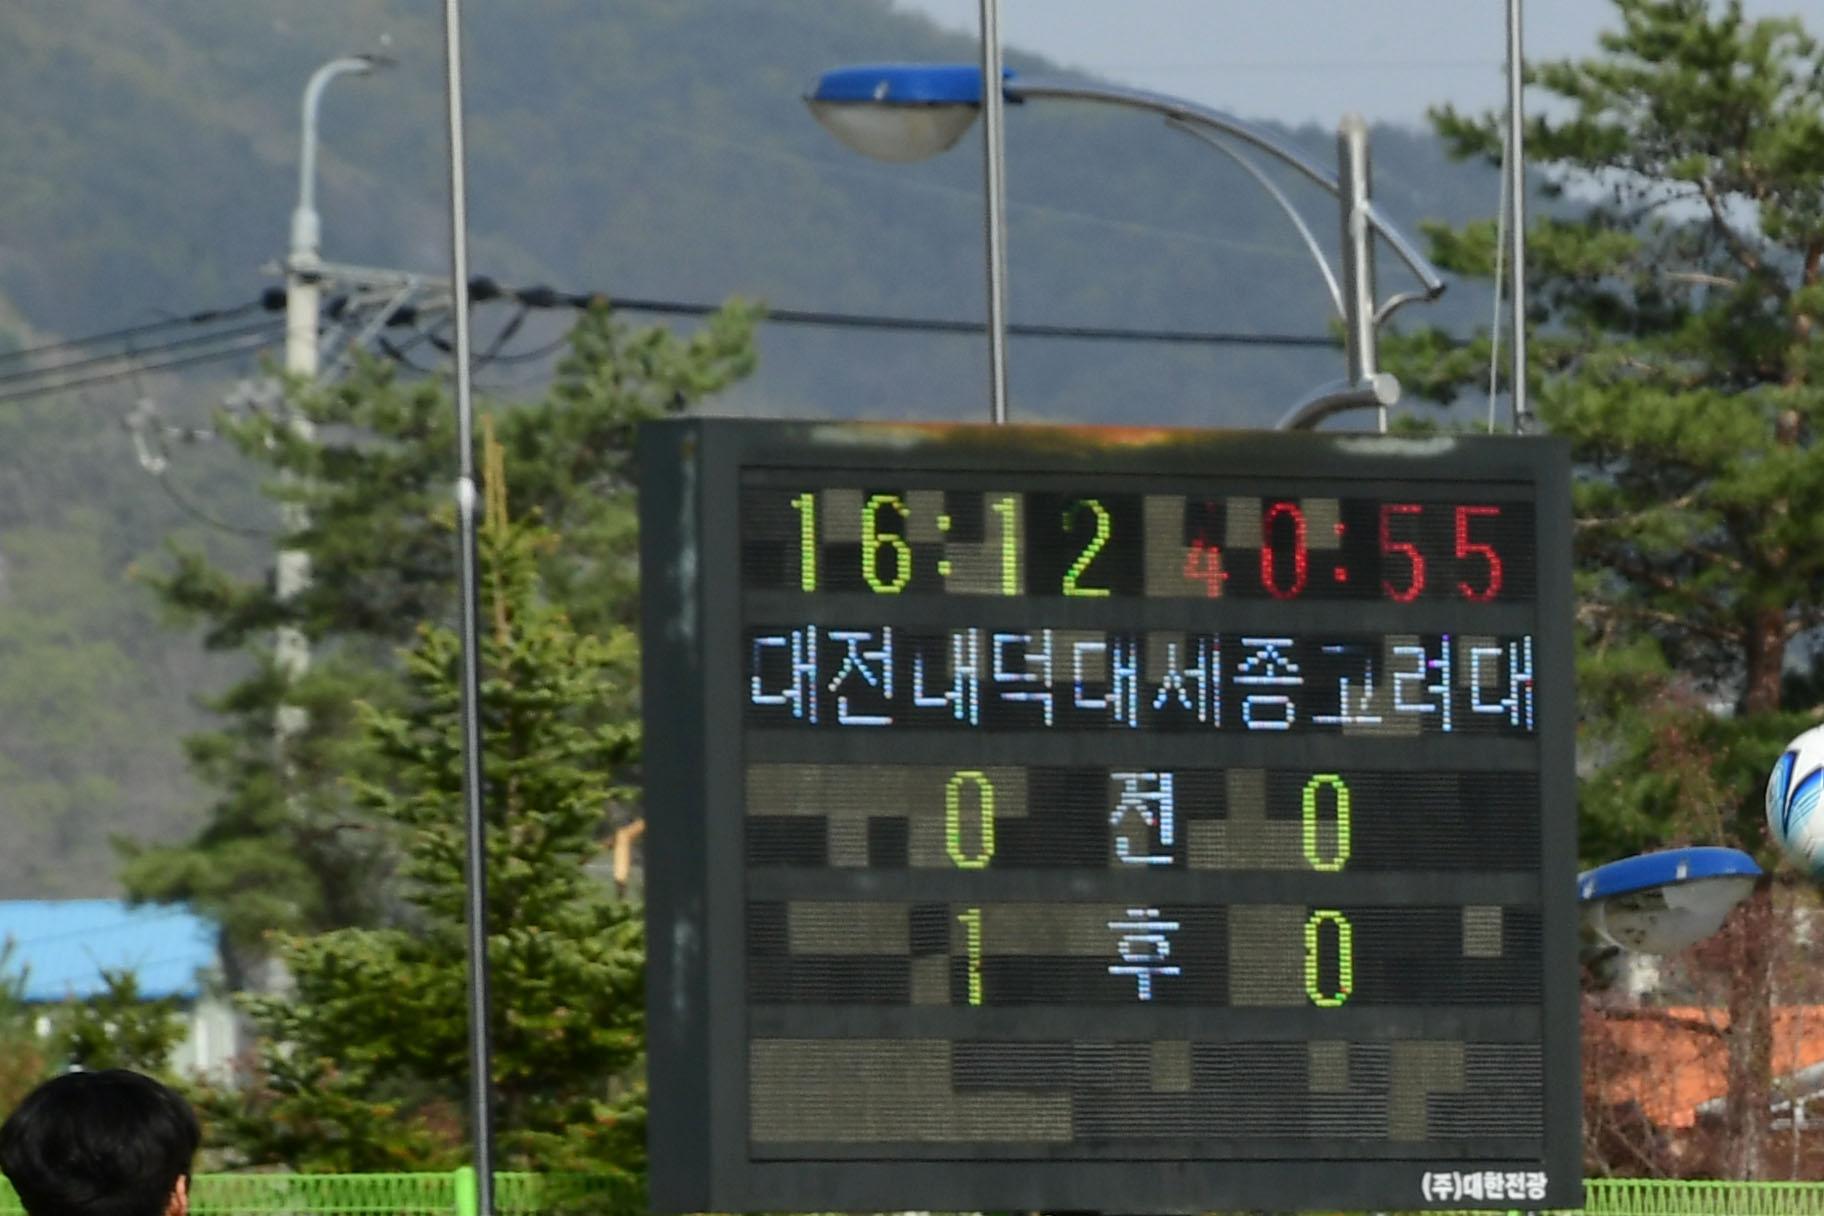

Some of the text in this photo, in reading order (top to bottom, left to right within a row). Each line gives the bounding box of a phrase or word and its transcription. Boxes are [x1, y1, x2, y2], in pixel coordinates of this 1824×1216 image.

[791, 493, 1111, 596] 16:12
[1183, 501, 1503, 602] 40:55
[945, 770, 1352, 871] 0 전 0
[957, 908, 1353, 1006] 1 후 0
[1421, 1171, 1549, 1202] (주)대한전광
